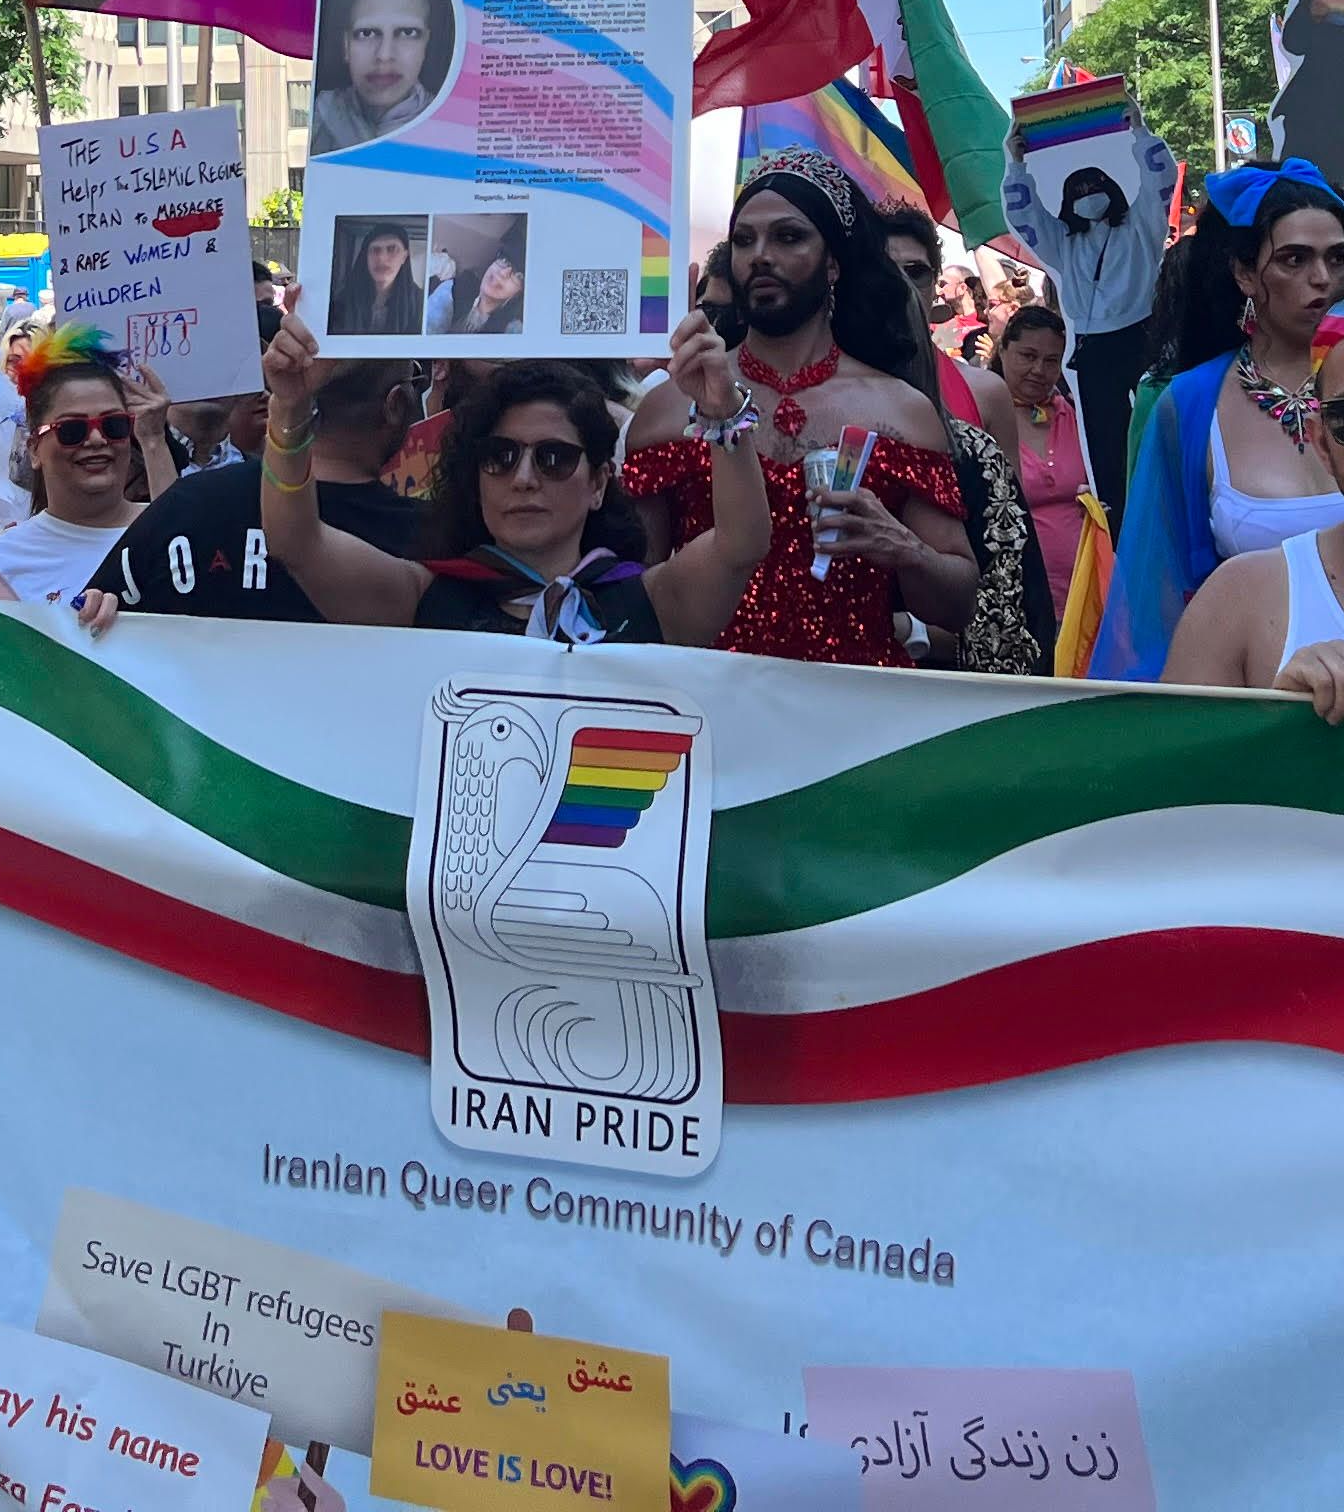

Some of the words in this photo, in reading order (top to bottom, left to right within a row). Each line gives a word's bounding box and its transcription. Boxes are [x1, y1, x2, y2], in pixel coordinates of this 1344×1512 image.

[61, 138, 102, 168] THE
[61, 178, 106, 215] Helps
[79, 208, 123, 236] IRAN
[157, 197, 223, 221] MASSACRE
[76, 250, 111, 273] RAPE
[449, 1085, 553, 1138] IRAN
[575, 1101, 702, 1158] PRIDE
[263, 1142, 388, 1197] Iranian
[400, 1159, 513, 1210] Queer
[525, 1175, 744, 1256] Community
[755, 1213, 794, 1255] of
[805, 1218, 956, 1286] Canada
[82, 1240, 154, 1285] Save
[162, 1260, 241, 1307] LGBT
[246, 1289, 376, 1347] refugees
[202, 1311, 230, 1347] In
[163, 1341, 268, 1401] Turkiye
[567, 1357, 633, 1393] عشق
[396, 1382, 462, 1416] عشق
[45, 1393, 97, 1442] his
[108, 1425, 200, 1477] name
[950, 1416, 1051, 1481] زندگی
[1064, 1431, 1120, 1481] زن
[415, 1440, 489, 1478] LOVE
[497, 1453, 521, 1482] IS
[530, 1459, 614, 1501] LOVE!
